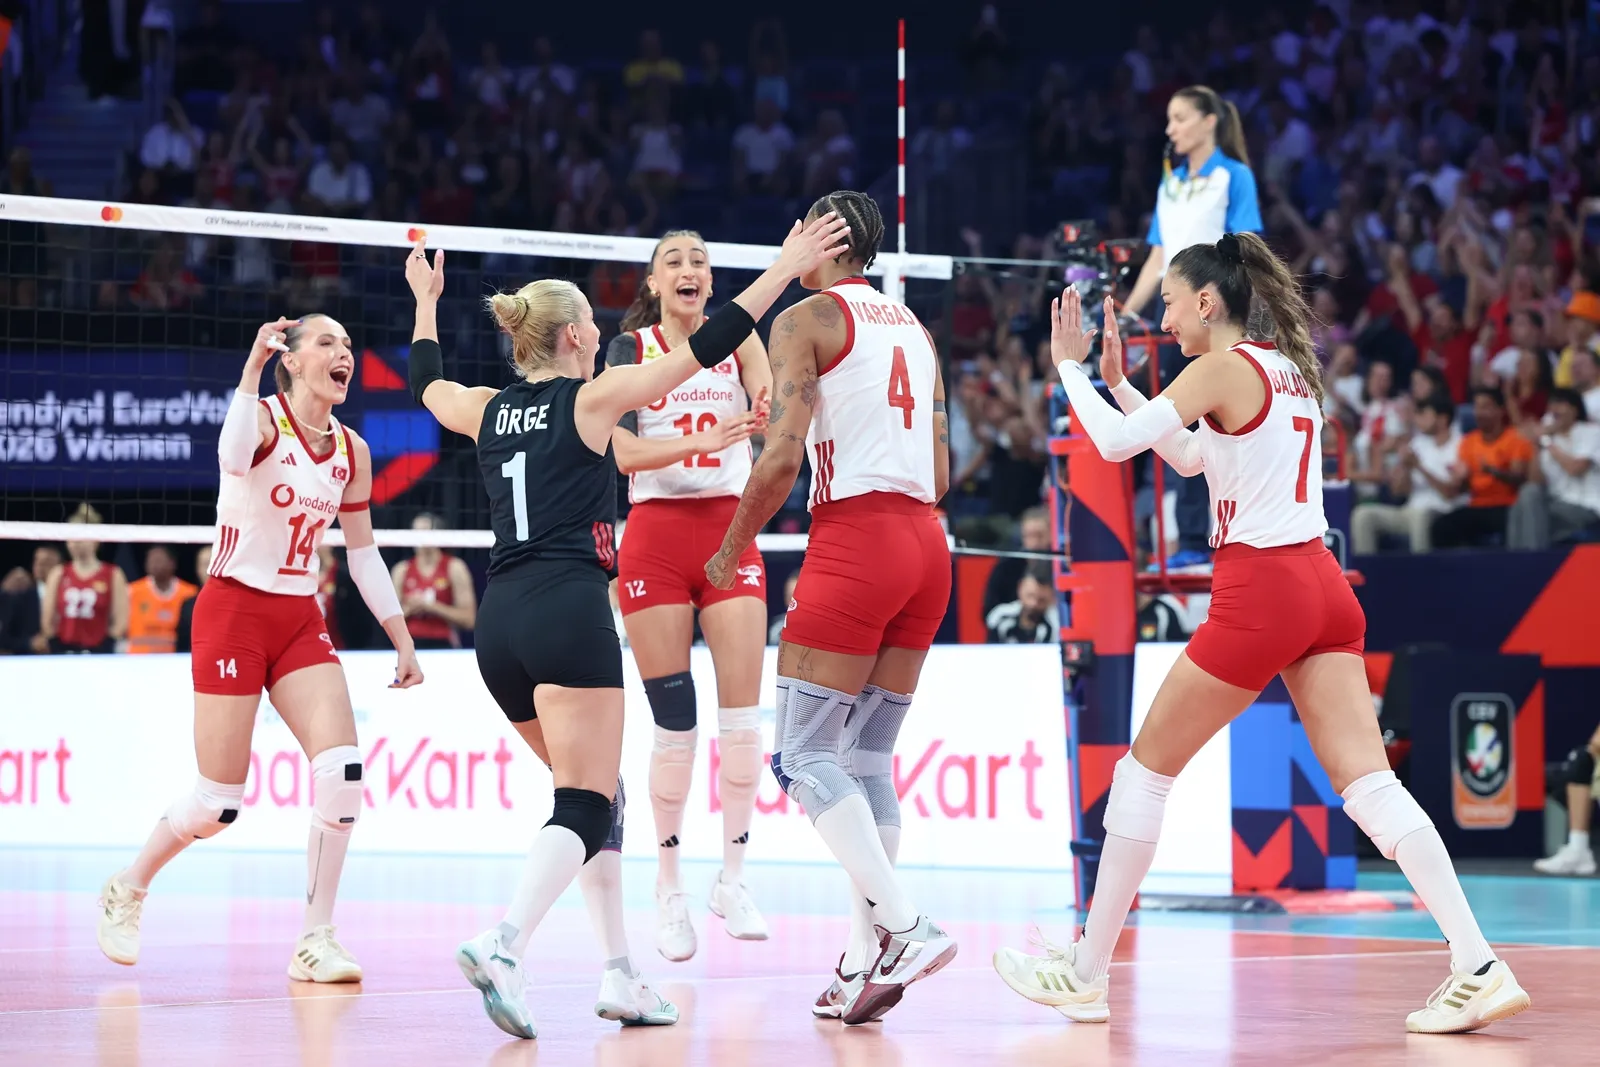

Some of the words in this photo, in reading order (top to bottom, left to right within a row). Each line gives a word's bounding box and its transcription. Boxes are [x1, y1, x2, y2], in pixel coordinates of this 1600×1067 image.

[849, 301, 916, 325] VARGAS
[671, 388, 733, 402] vodafone
[887, 346, 915, 430] 4
[495, 404, 550, 435] ÖRGE
[64, 428, 191, 461] Women
[674, 412, 721, 468] 12
[1292, 415, 1314, 503] 7
[501, 451, 529, 541] 1
[286, 512, 325, 568] 14
[64, 587, 97, 620] 22
[625, 579, 647, 599] 12
[216, 658, 238, 679] 14
